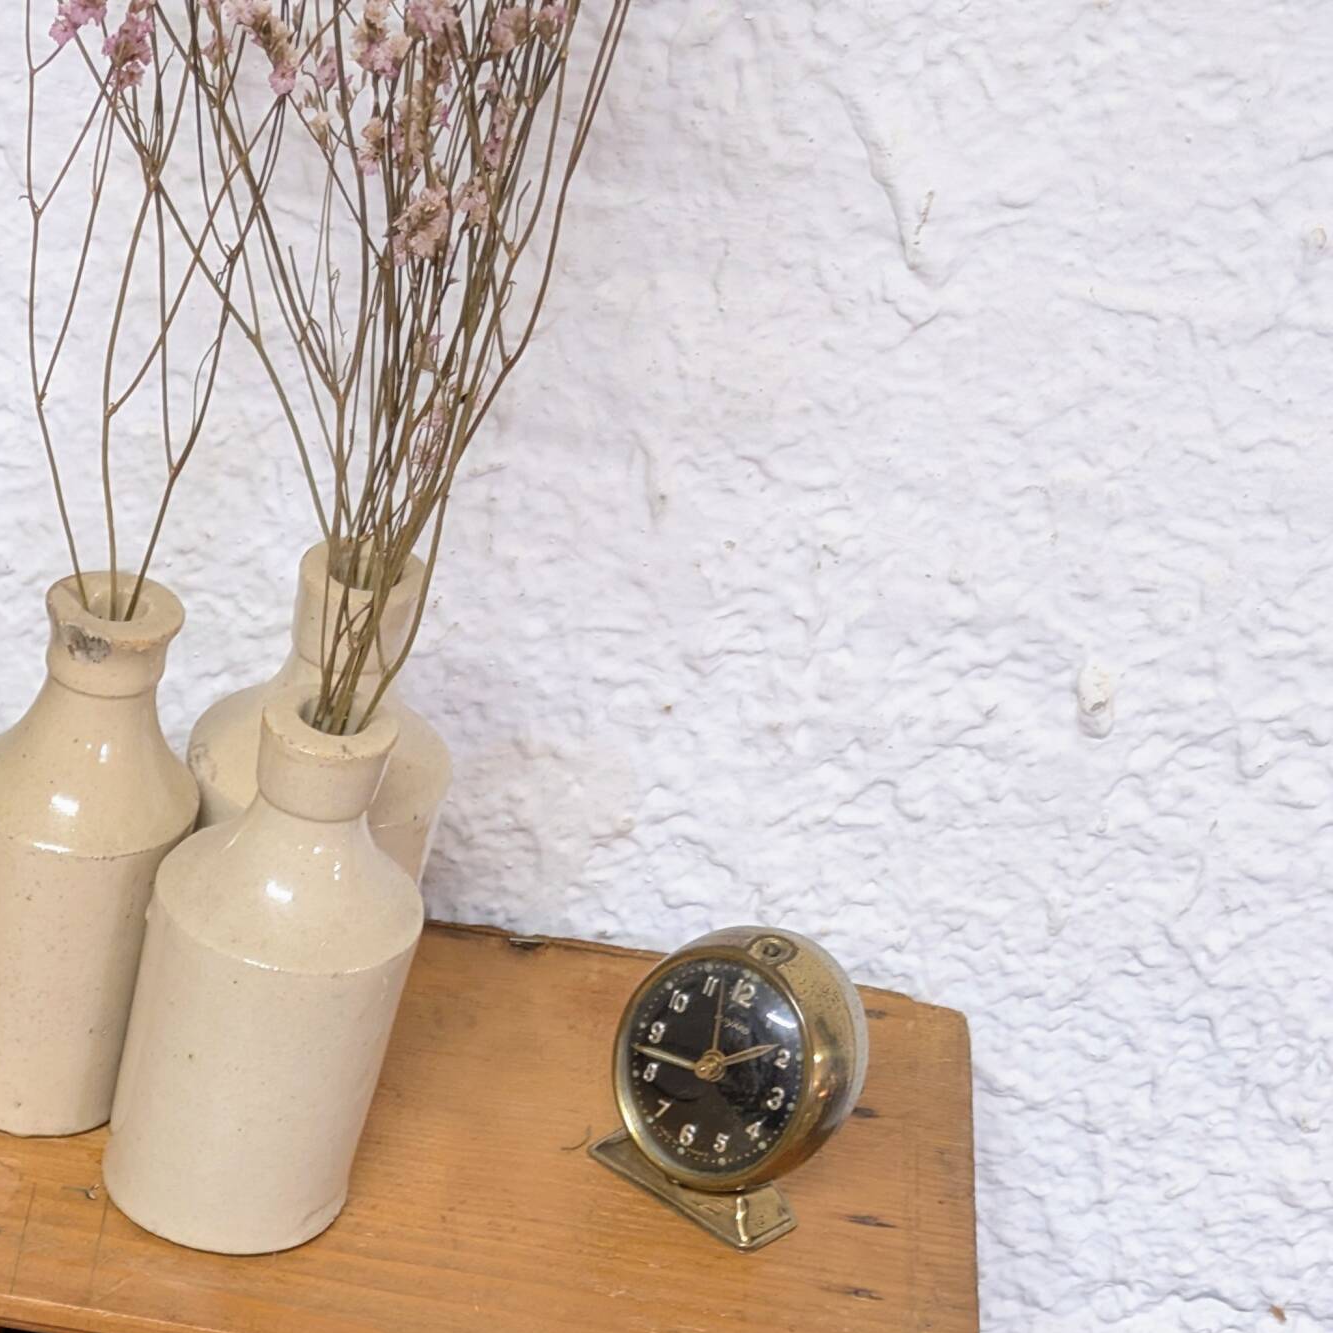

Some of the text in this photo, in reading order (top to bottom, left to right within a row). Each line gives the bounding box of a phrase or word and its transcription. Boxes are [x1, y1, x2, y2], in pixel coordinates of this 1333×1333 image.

[702, 976, 719, 996] 11
[732, 978, 756, 1008] 12
[668, 989, 689, 1013] 10
[648, 1021, 666, 1044] 9
[774, 1049, 791, 1069] 2
[643, 1063, 659, 1082] 8
[655, 1099, 672, 1118] 7
[766, 1087, 785, 1111] 3
[679, 1124, 697, 1146] 6
[745, 1121, 763, 1140] 4
[713, 1132, 730, 1152] 5
